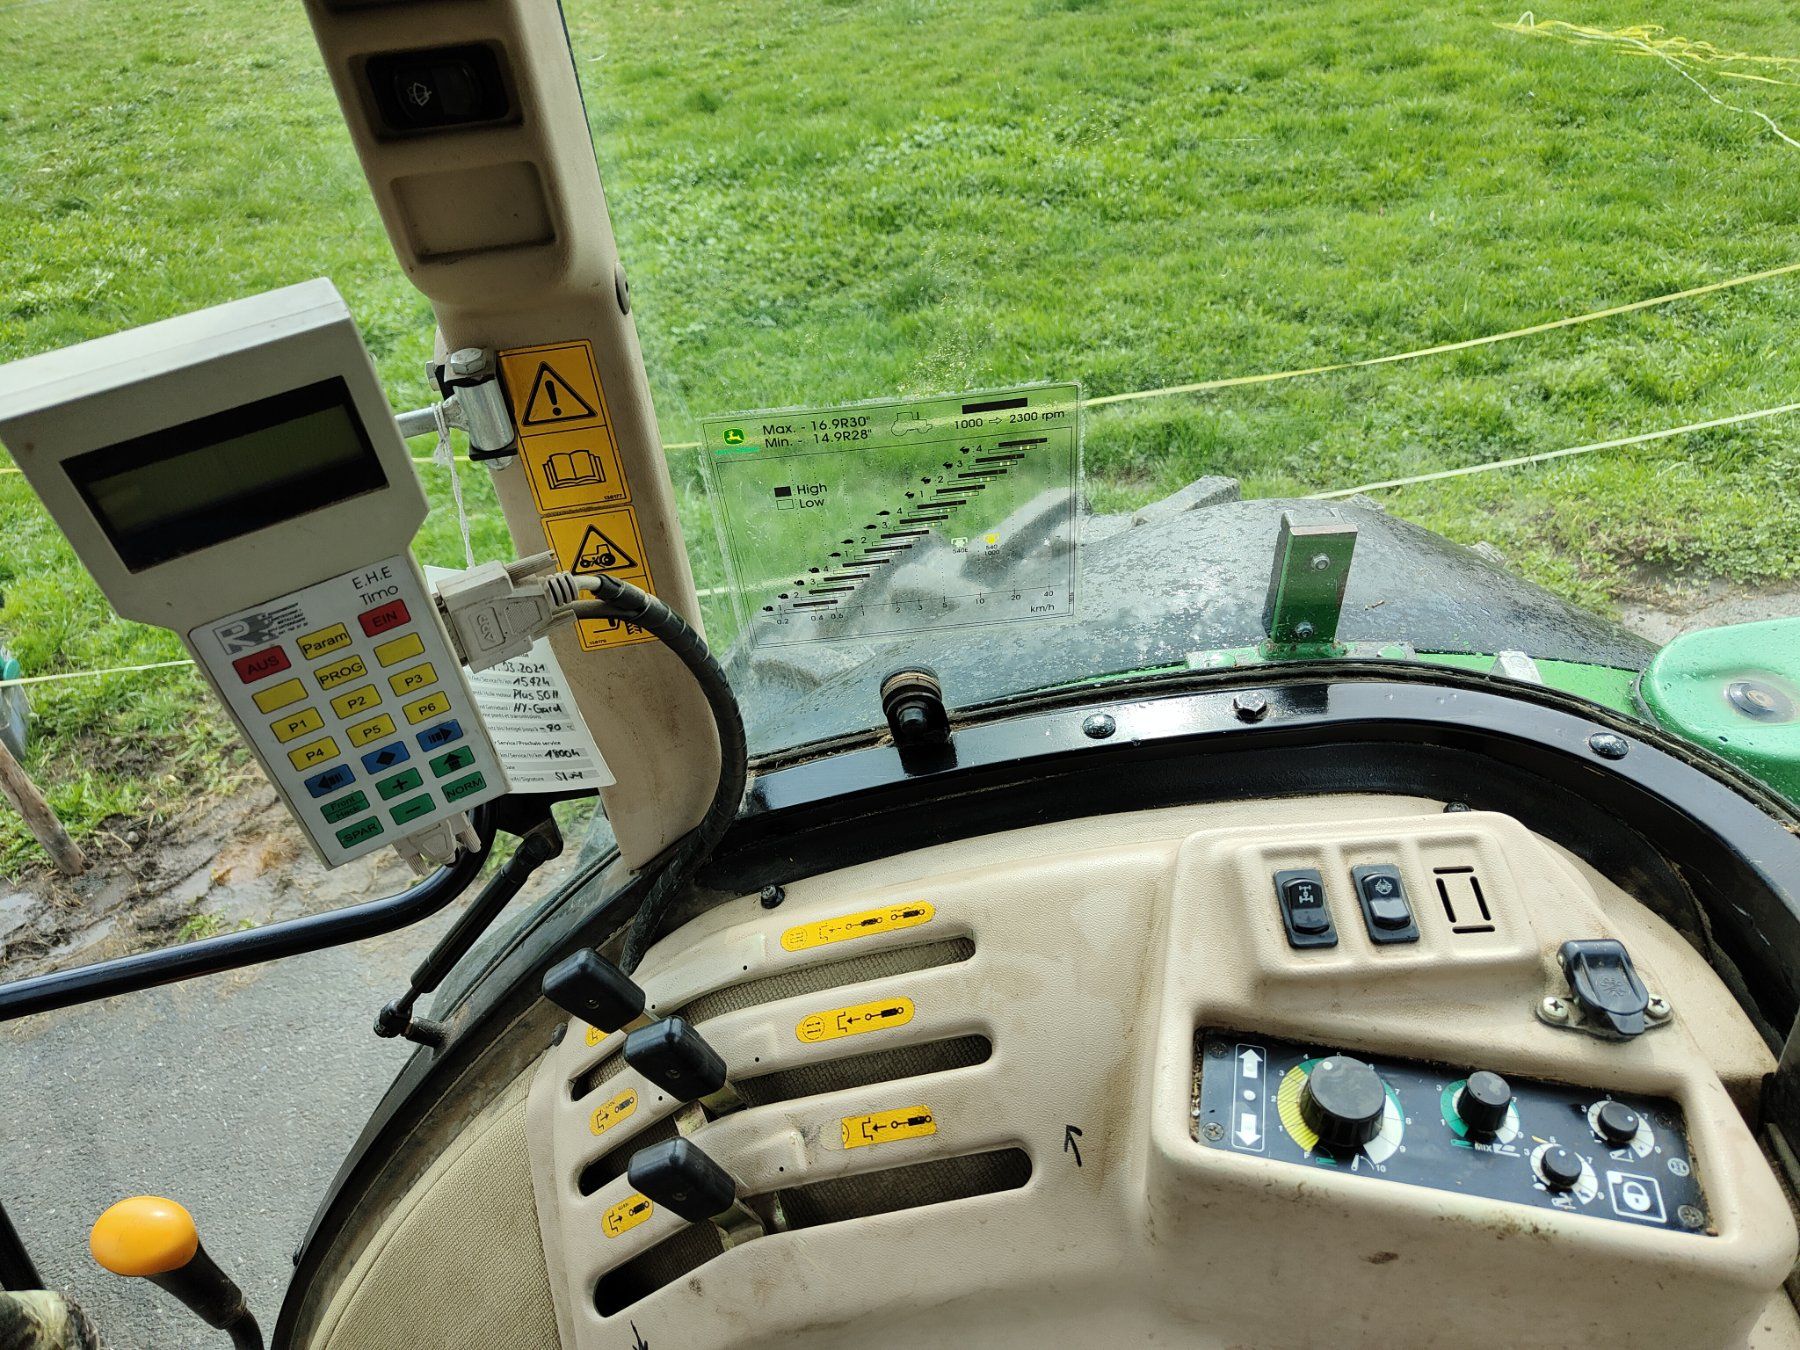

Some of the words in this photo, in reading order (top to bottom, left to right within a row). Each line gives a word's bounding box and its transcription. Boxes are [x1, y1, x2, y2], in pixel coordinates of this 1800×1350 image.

[955, 418, 984, 430] 1000
[1010, 412, 1038, 424] 2300
[1042, 411, 1065, 421] rpm
[763, 425, 796, 436] Max.
[765, 438, 793, 448] Min.
[797, 483, 828, 496] High
[799, 499, 825, 509] Low
[352, 566, 393, 590] E.H.E
[359, 585, 399, 606] Timo
[1030, 604, 1055, 613] km/h
[372, 611, 398, 627] EIN
[302, 632, 348, 654] Param
[247, 656, 280, 675] AUS
[319, 662, 363, 684] PROG
[404, 674, 423, 687] P3
[348, 696, 366, 709] P2
[419, 703, 436, 715] P6
[288, 720, 307, 732] P1
[363, 725, 381, 738] P5
[306, 748, 325, 761] P4
[447, 778, 483, 798] NORM
[343, 822, 379, 842] SPAR
[1474, 1142, 1493, 1152] MIX
[1375, 1164, 1387, 1173] 10
